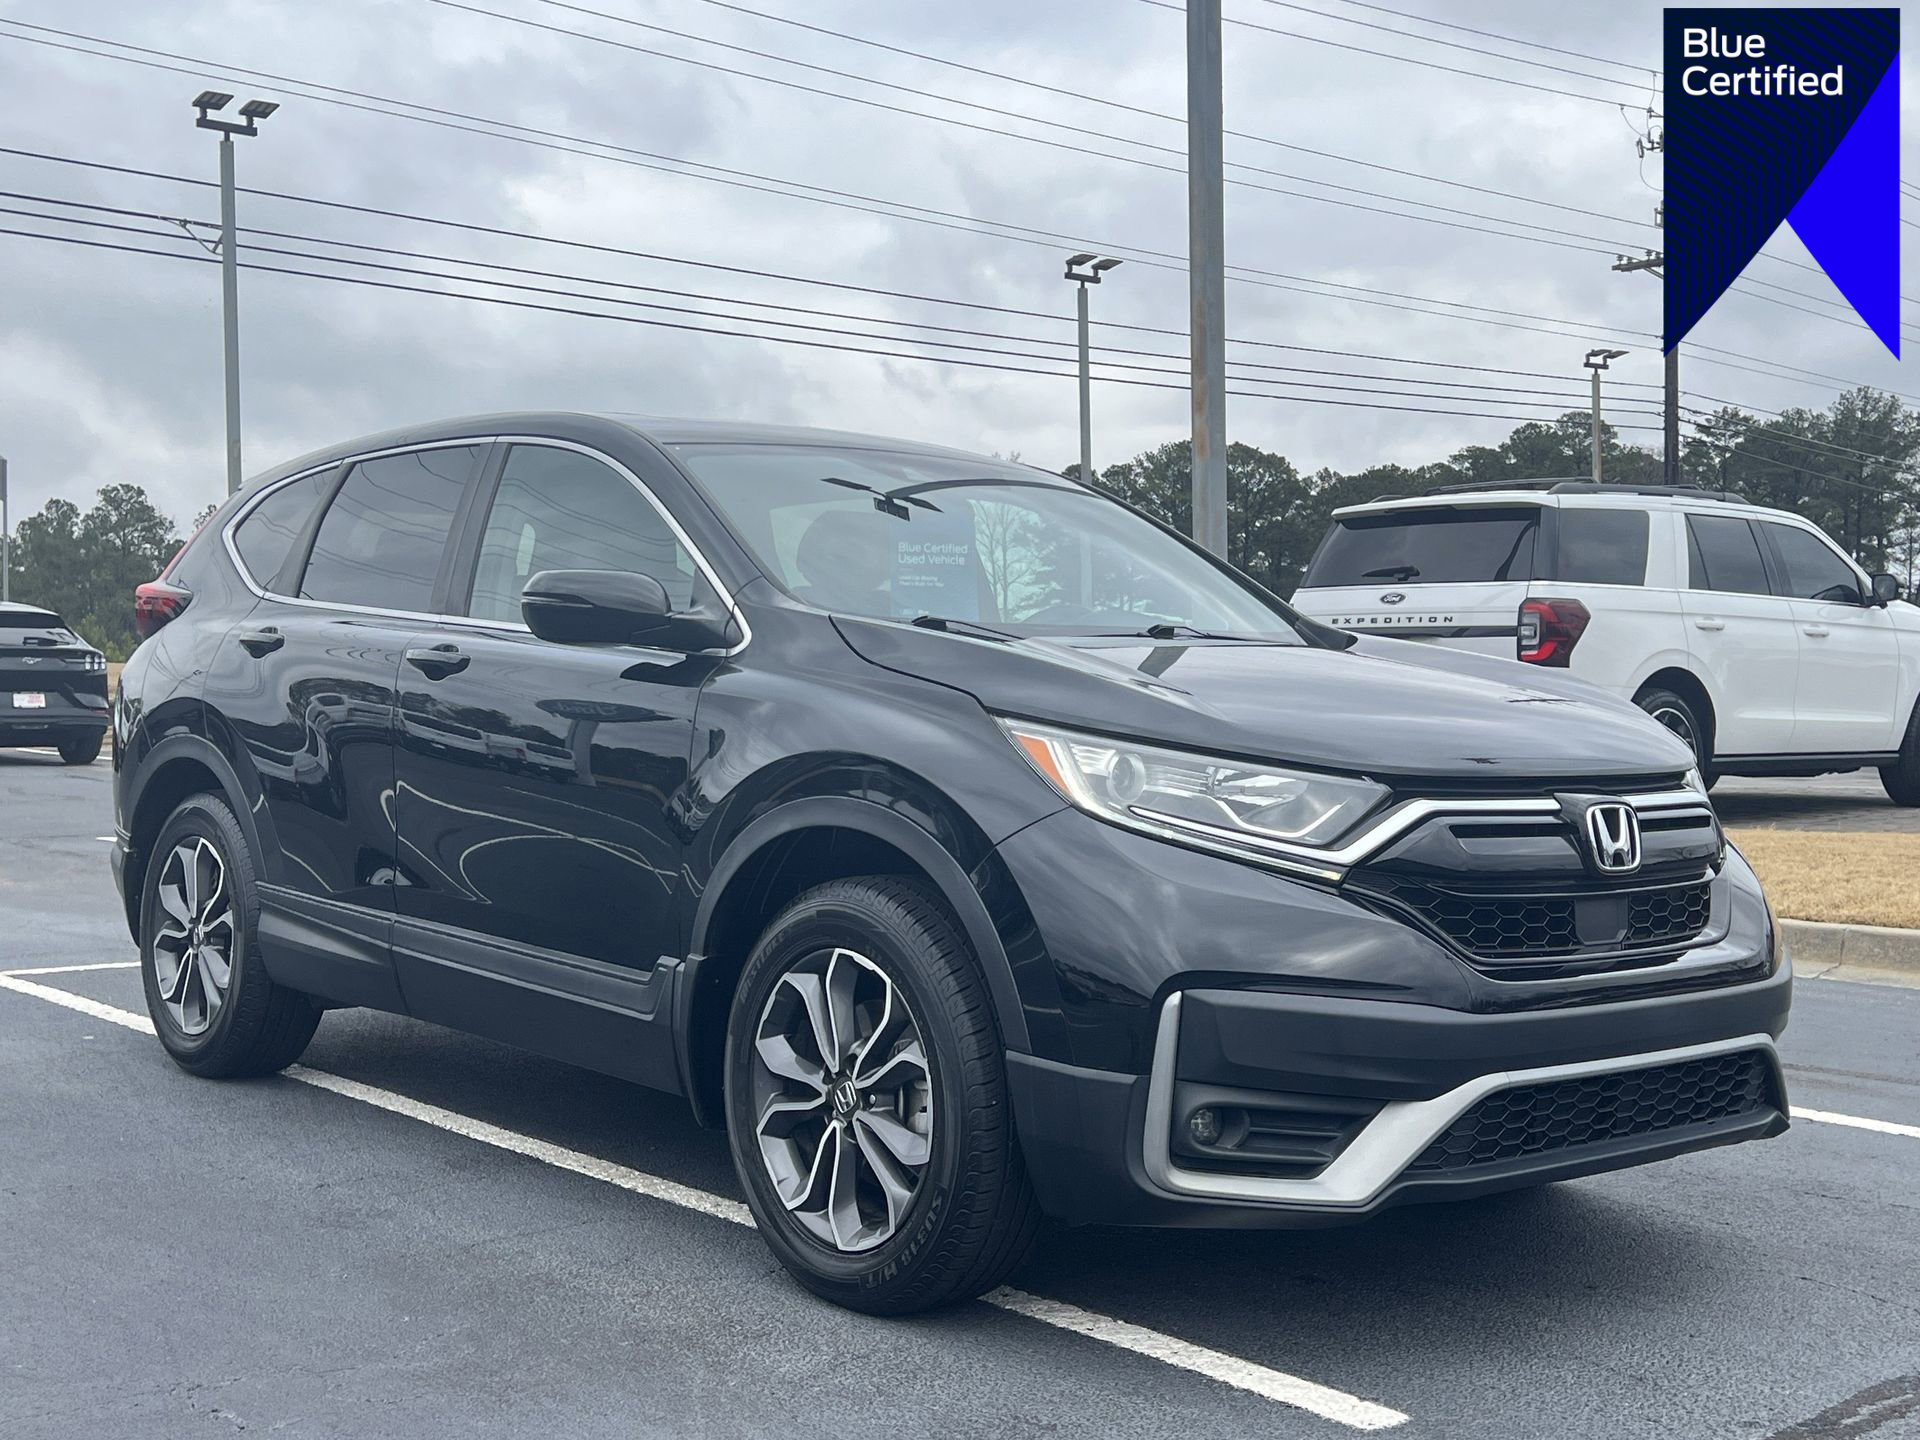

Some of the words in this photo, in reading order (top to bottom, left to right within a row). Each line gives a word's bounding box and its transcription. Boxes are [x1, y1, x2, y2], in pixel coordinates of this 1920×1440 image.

[898, 542, 921, 553] Blue
[923, 542, 968, 554] Certified
[898, 553, 925, 564] Used
[927, 554, 966, 565] Vehicle
[1331, 616, 1454, 625] EXPEDITION
[900, 1189, 942, 1267] SU318
